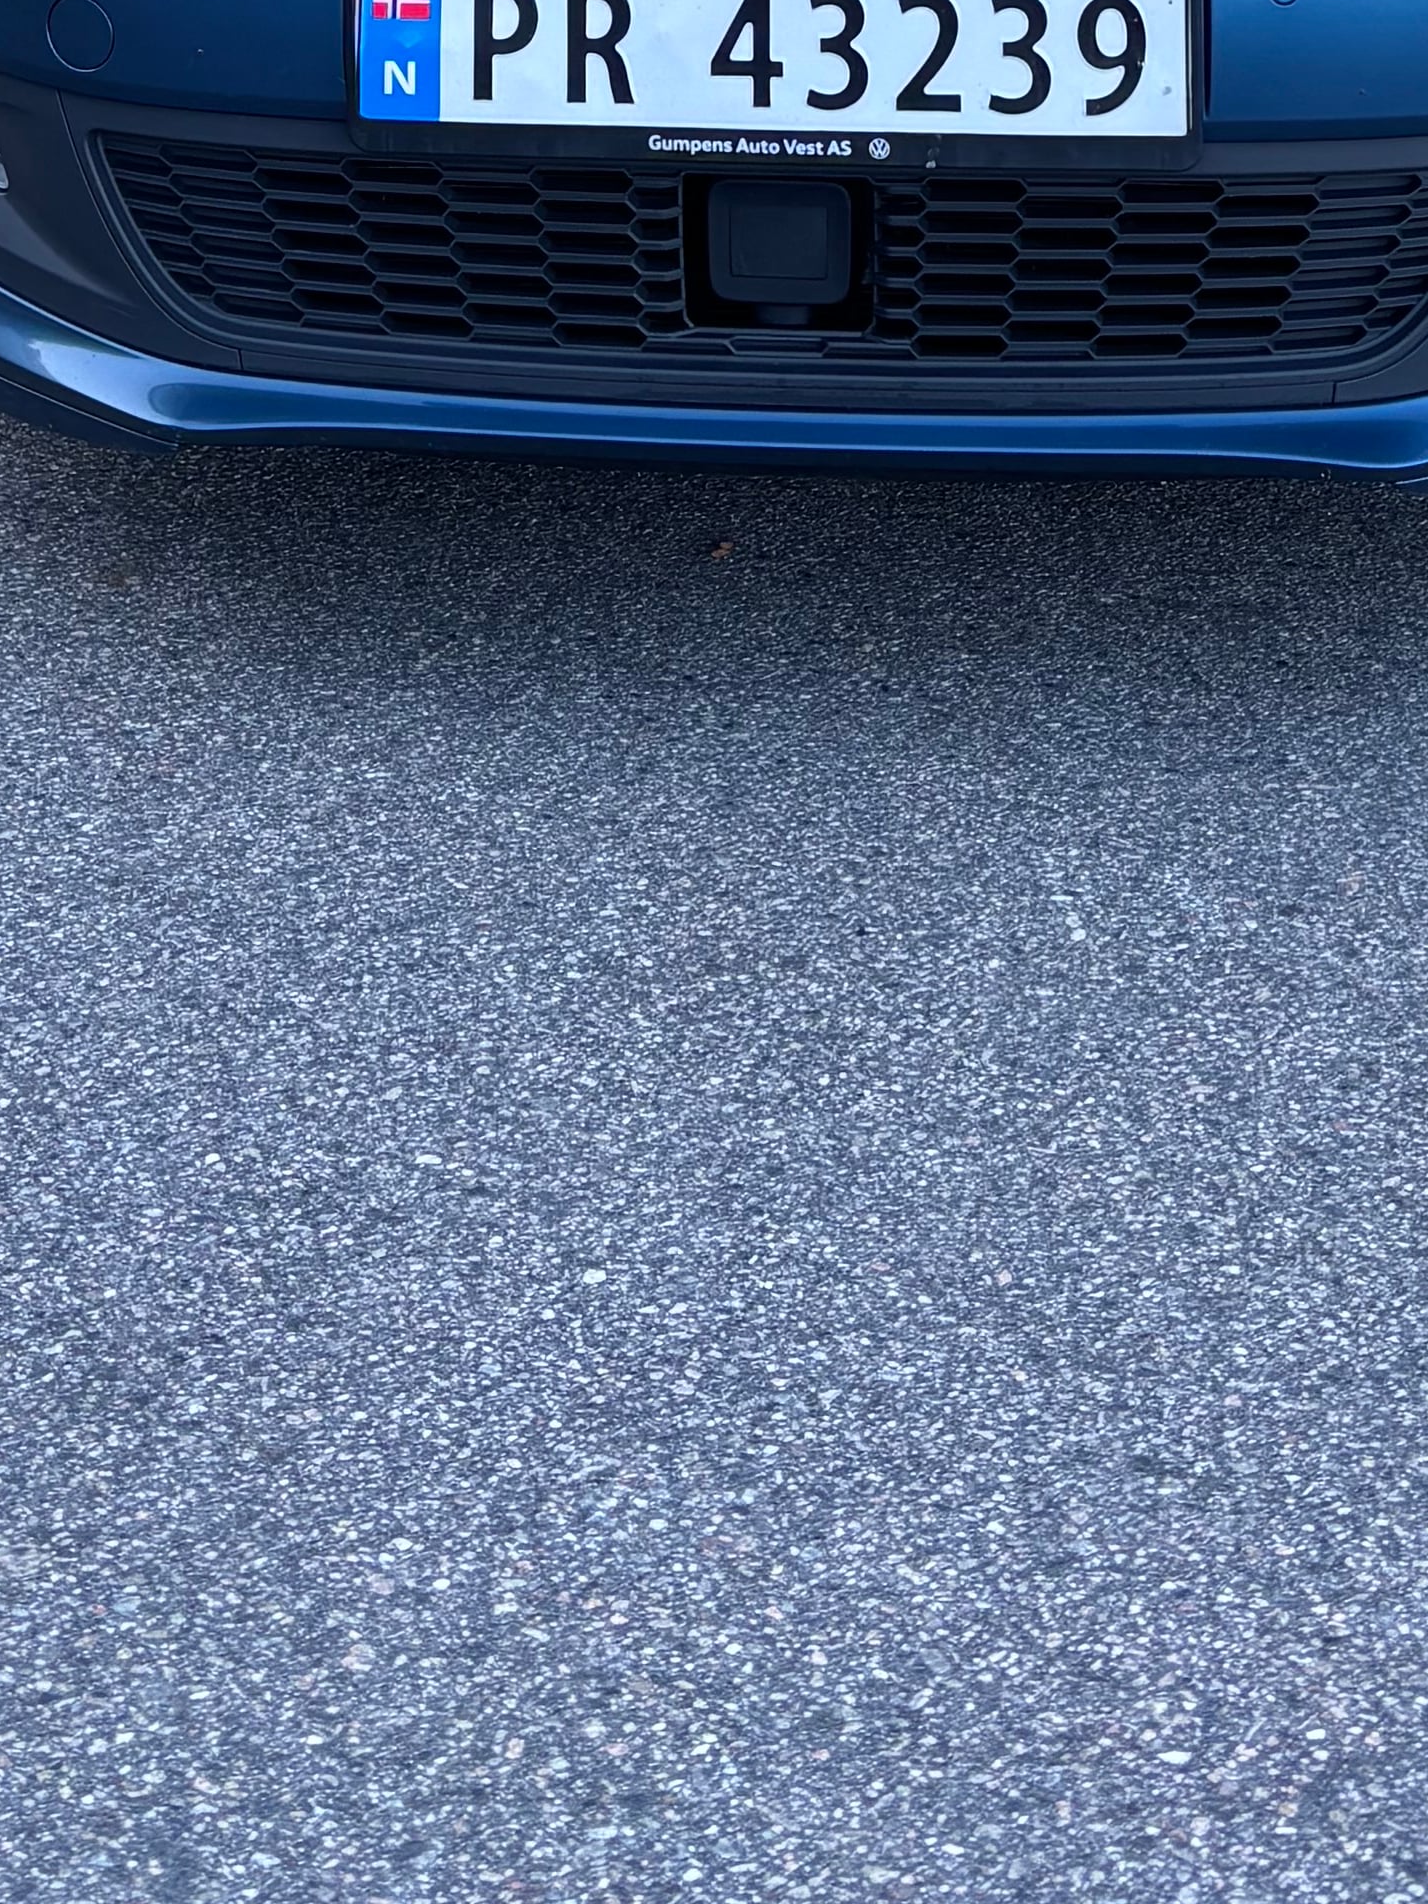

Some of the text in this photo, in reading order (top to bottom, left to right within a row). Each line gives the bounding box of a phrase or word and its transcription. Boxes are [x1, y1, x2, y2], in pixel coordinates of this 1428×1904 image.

[382, 58, 417, 96] N
[647, 134, 853, 157] Gumpens Auto Vest AS
